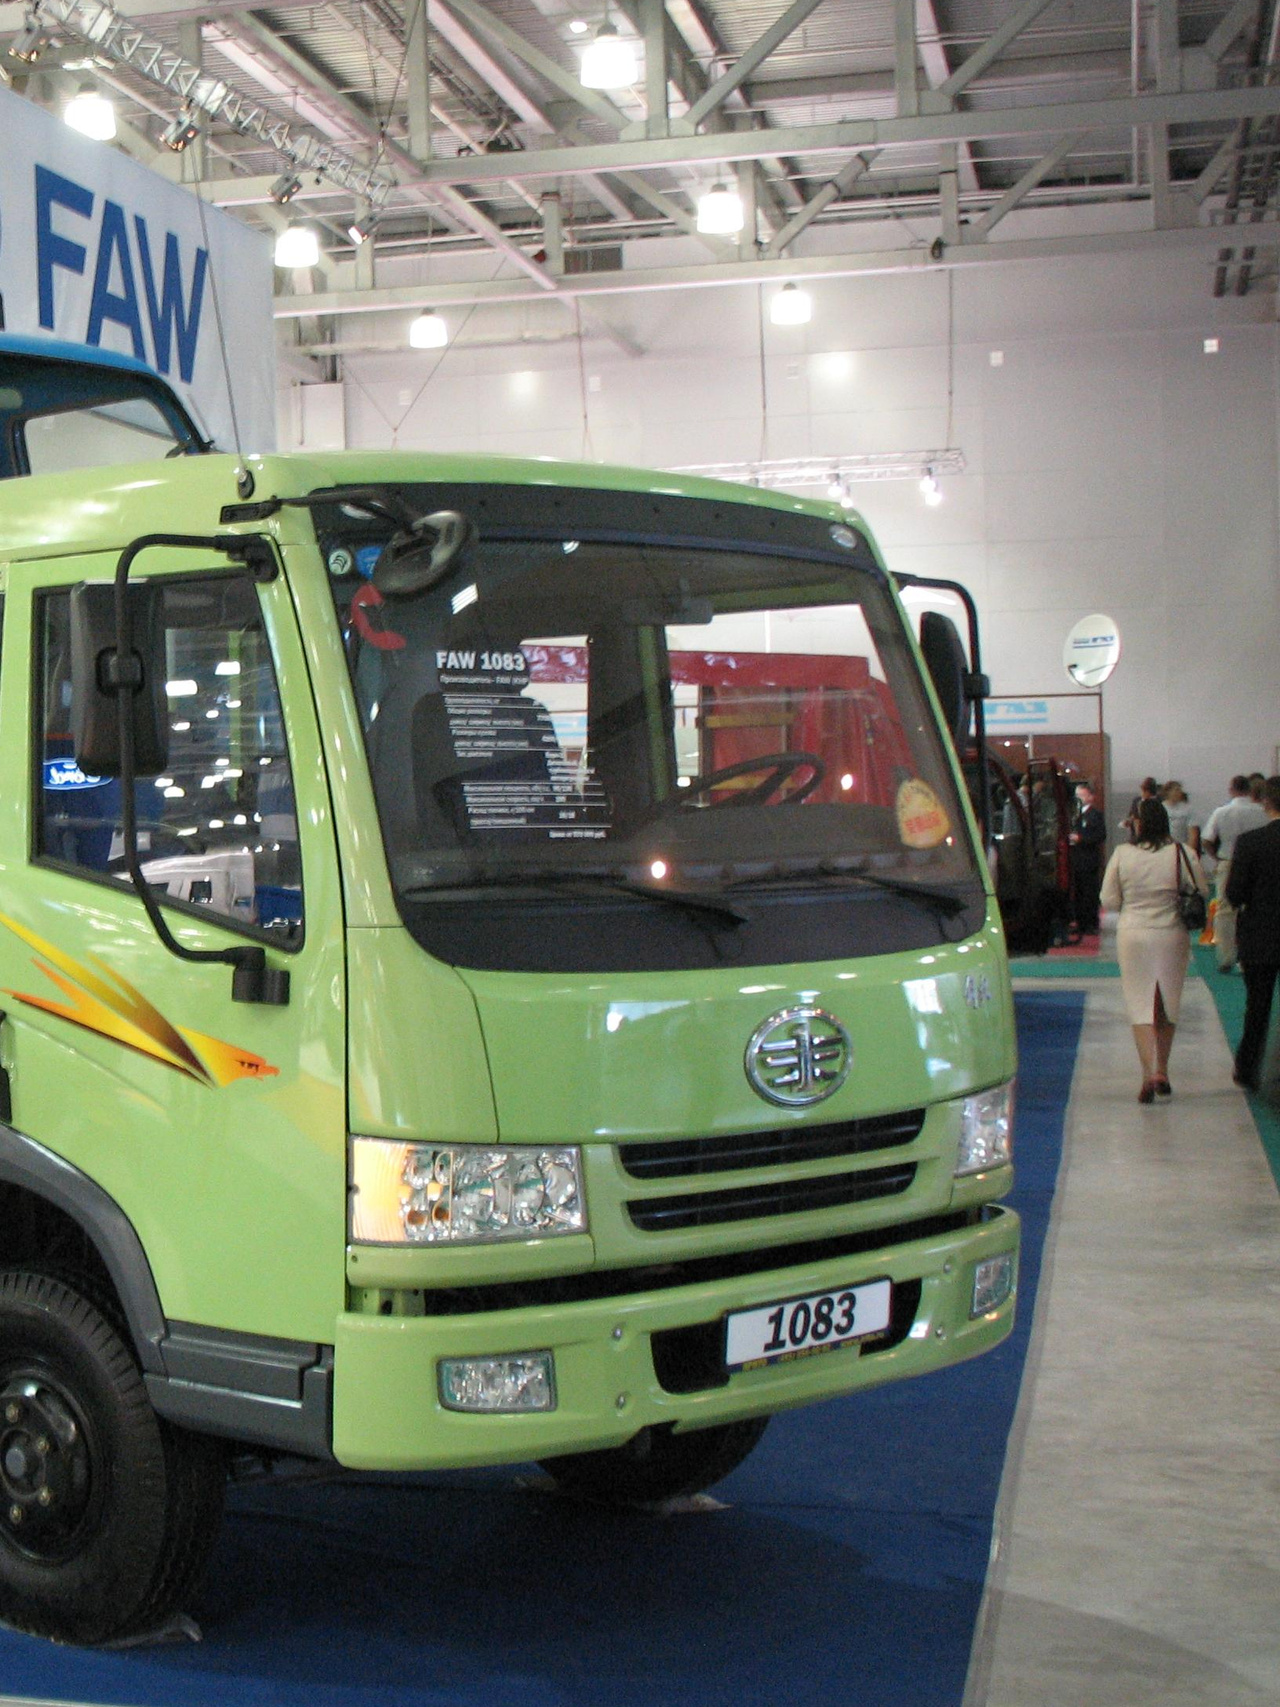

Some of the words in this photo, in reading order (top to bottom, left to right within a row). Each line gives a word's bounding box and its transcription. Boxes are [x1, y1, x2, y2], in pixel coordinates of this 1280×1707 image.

[35, 164, 208, 384] FAW
[436, 651, 476, 670] FAW
[480, 652, 526, 671] 1083
[763, 1291, 856, 1353] 1083
